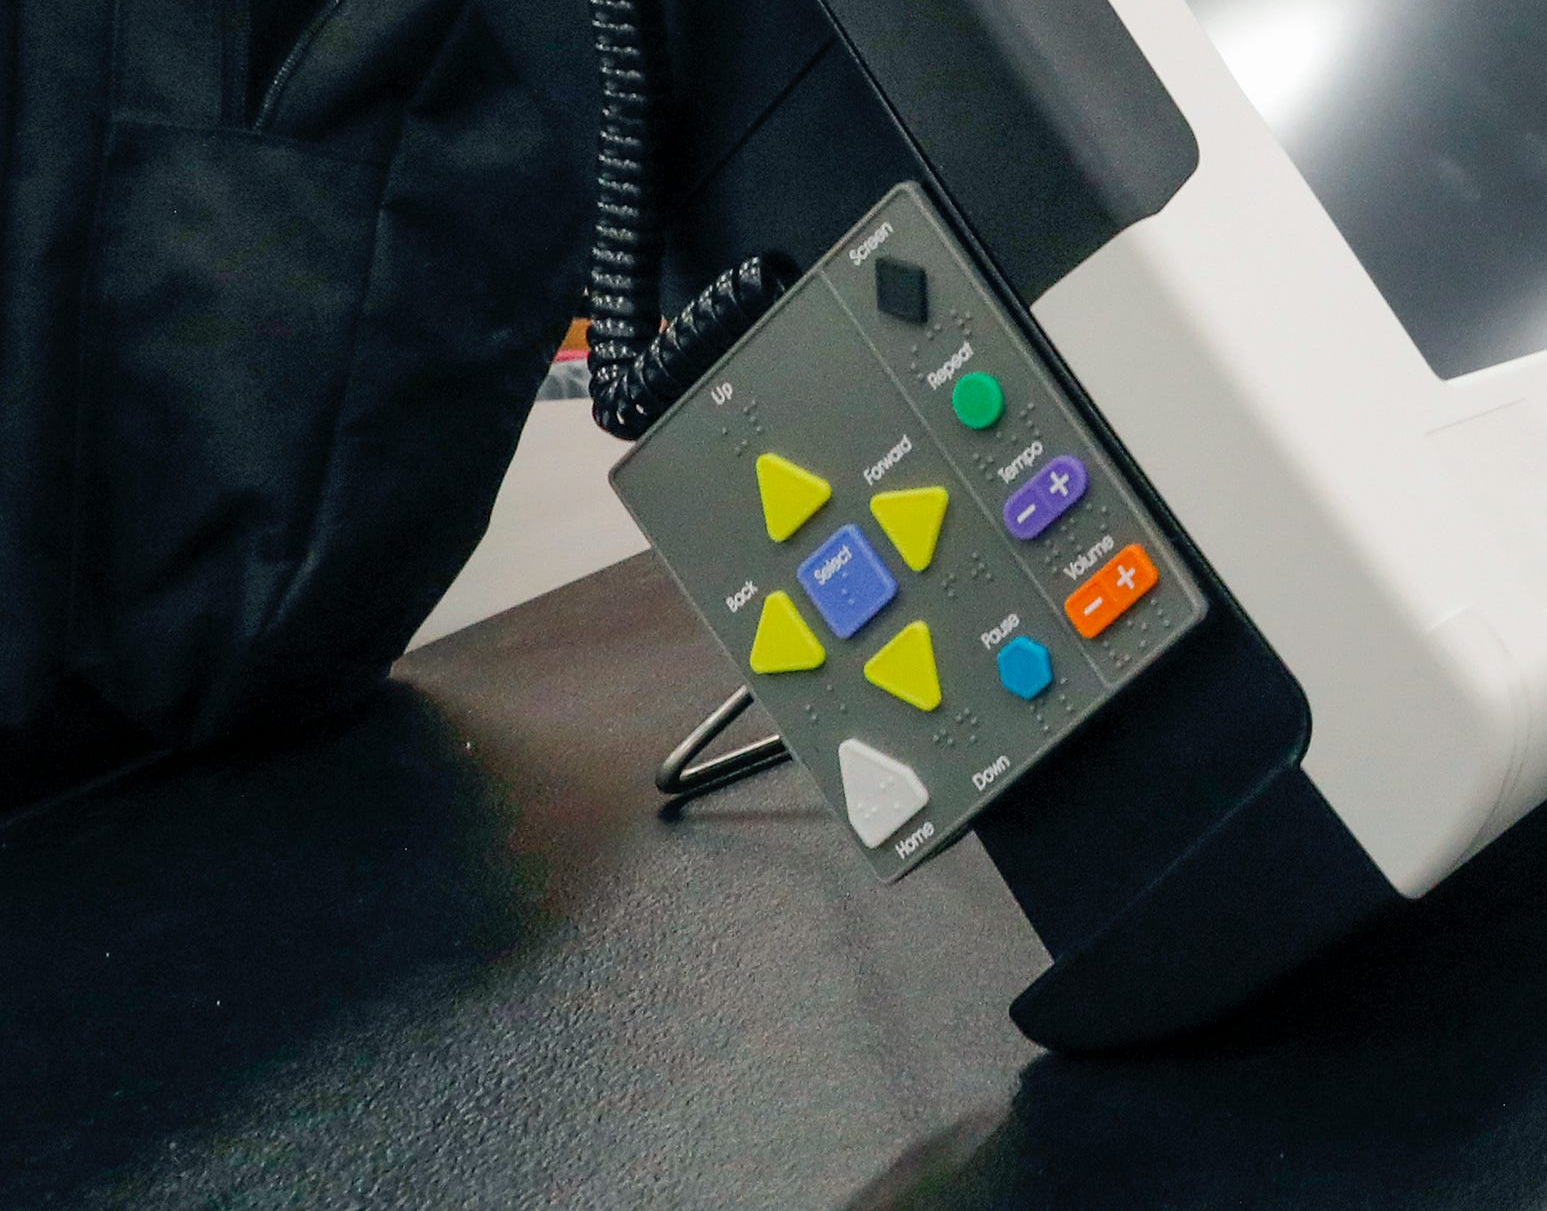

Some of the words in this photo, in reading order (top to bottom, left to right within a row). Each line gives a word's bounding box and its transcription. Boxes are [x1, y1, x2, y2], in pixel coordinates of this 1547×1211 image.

[849, 221, 894, 266] Screen
[927, 341, 974, 390] Repeat
[711, 381, 733, 406] Up
[863, 434, 912, 486] Forward
[997, 441, 1043, 484] Tempo
[814, 545, 852, 586] Select
[1063, 534, 1114, 580] Volume
[726, 580, 758, 613] Back
[980, 614, 1020, 650] Pause
[971, 755, 1010, 791] Down
[895, 821, 934, 860] Home
